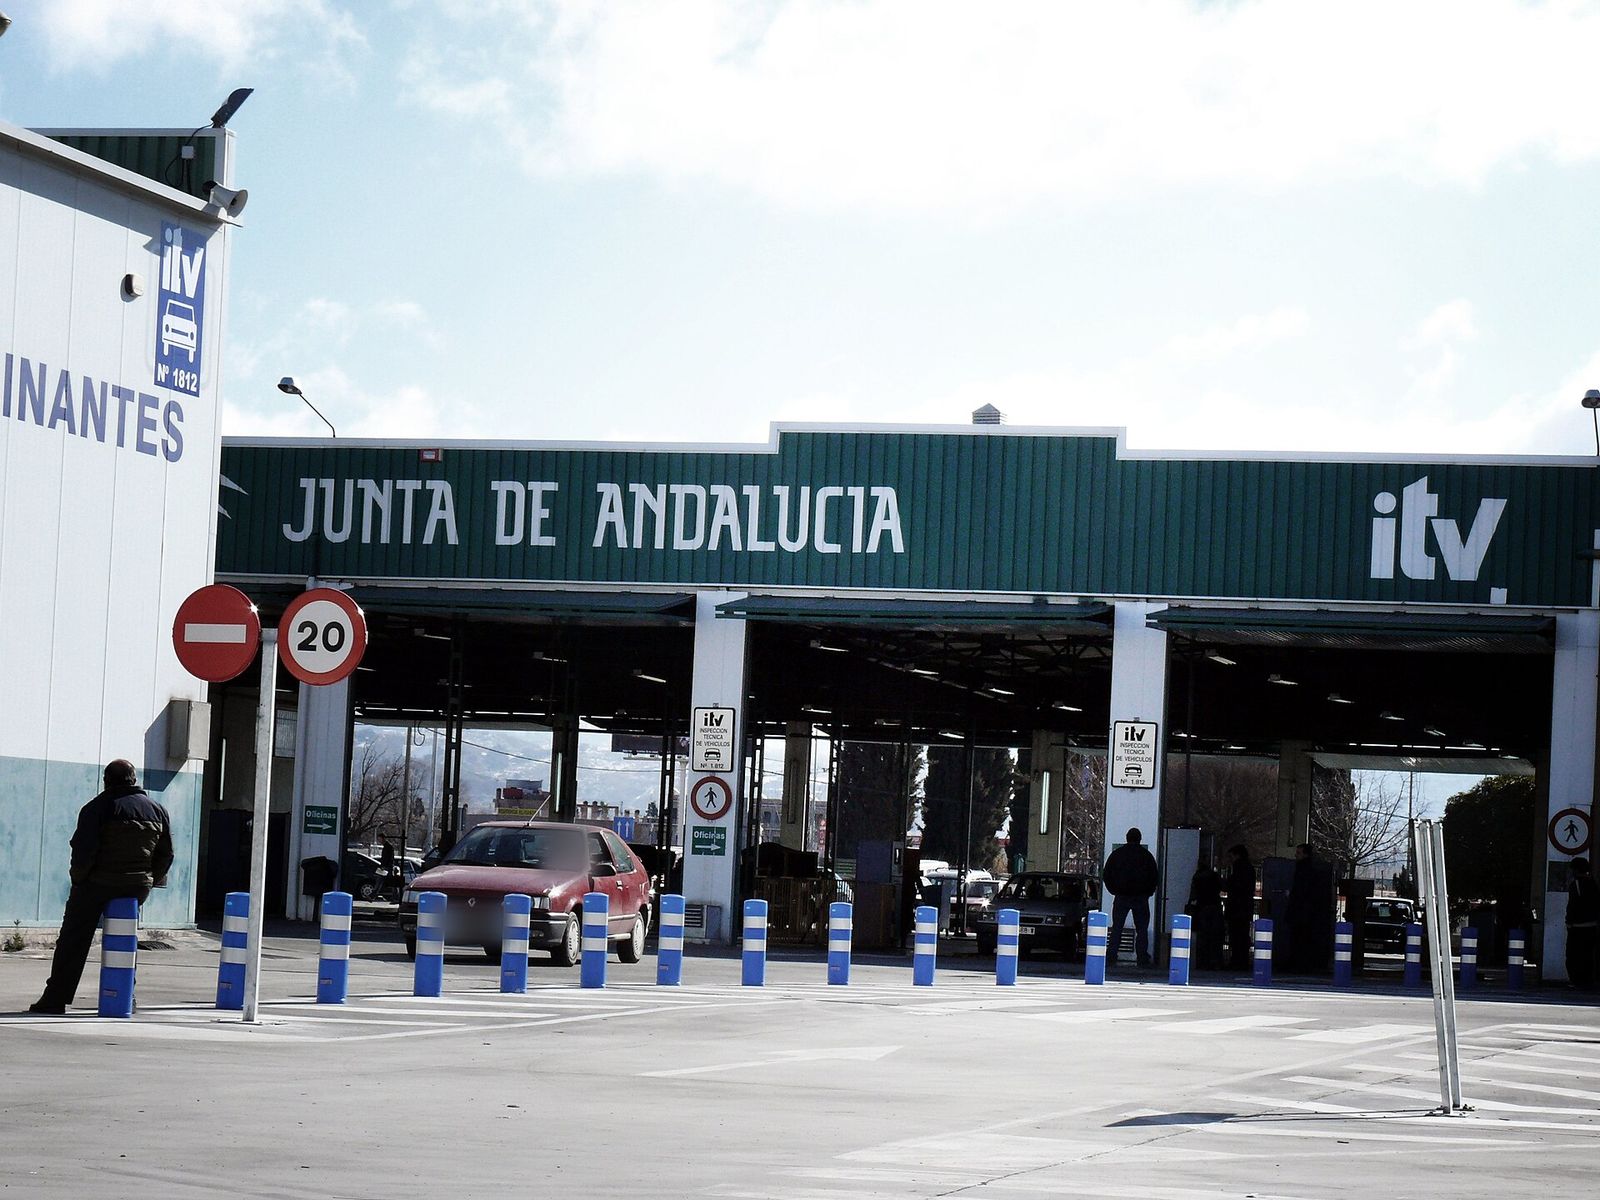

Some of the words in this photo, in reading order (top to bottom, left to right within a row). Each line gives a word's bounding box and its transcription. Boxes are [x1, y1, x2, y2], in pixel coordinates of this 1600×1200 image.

[161, 227, 204, 299] itv
[173, 367, 198, 393] 1812
[283, 477, 459, 546] JUNTA
[491, 481, 557, 547] DE
[593, 483, 905, 554] ANDALUCIA
[297, 620, 345, 653] 20
[704, 711, 724, 726] itv
[1124, 726, 1146, 741] itv
[306, 810, 336, 819] Oficinas
[694, 831, 725, 839] Oficinas
